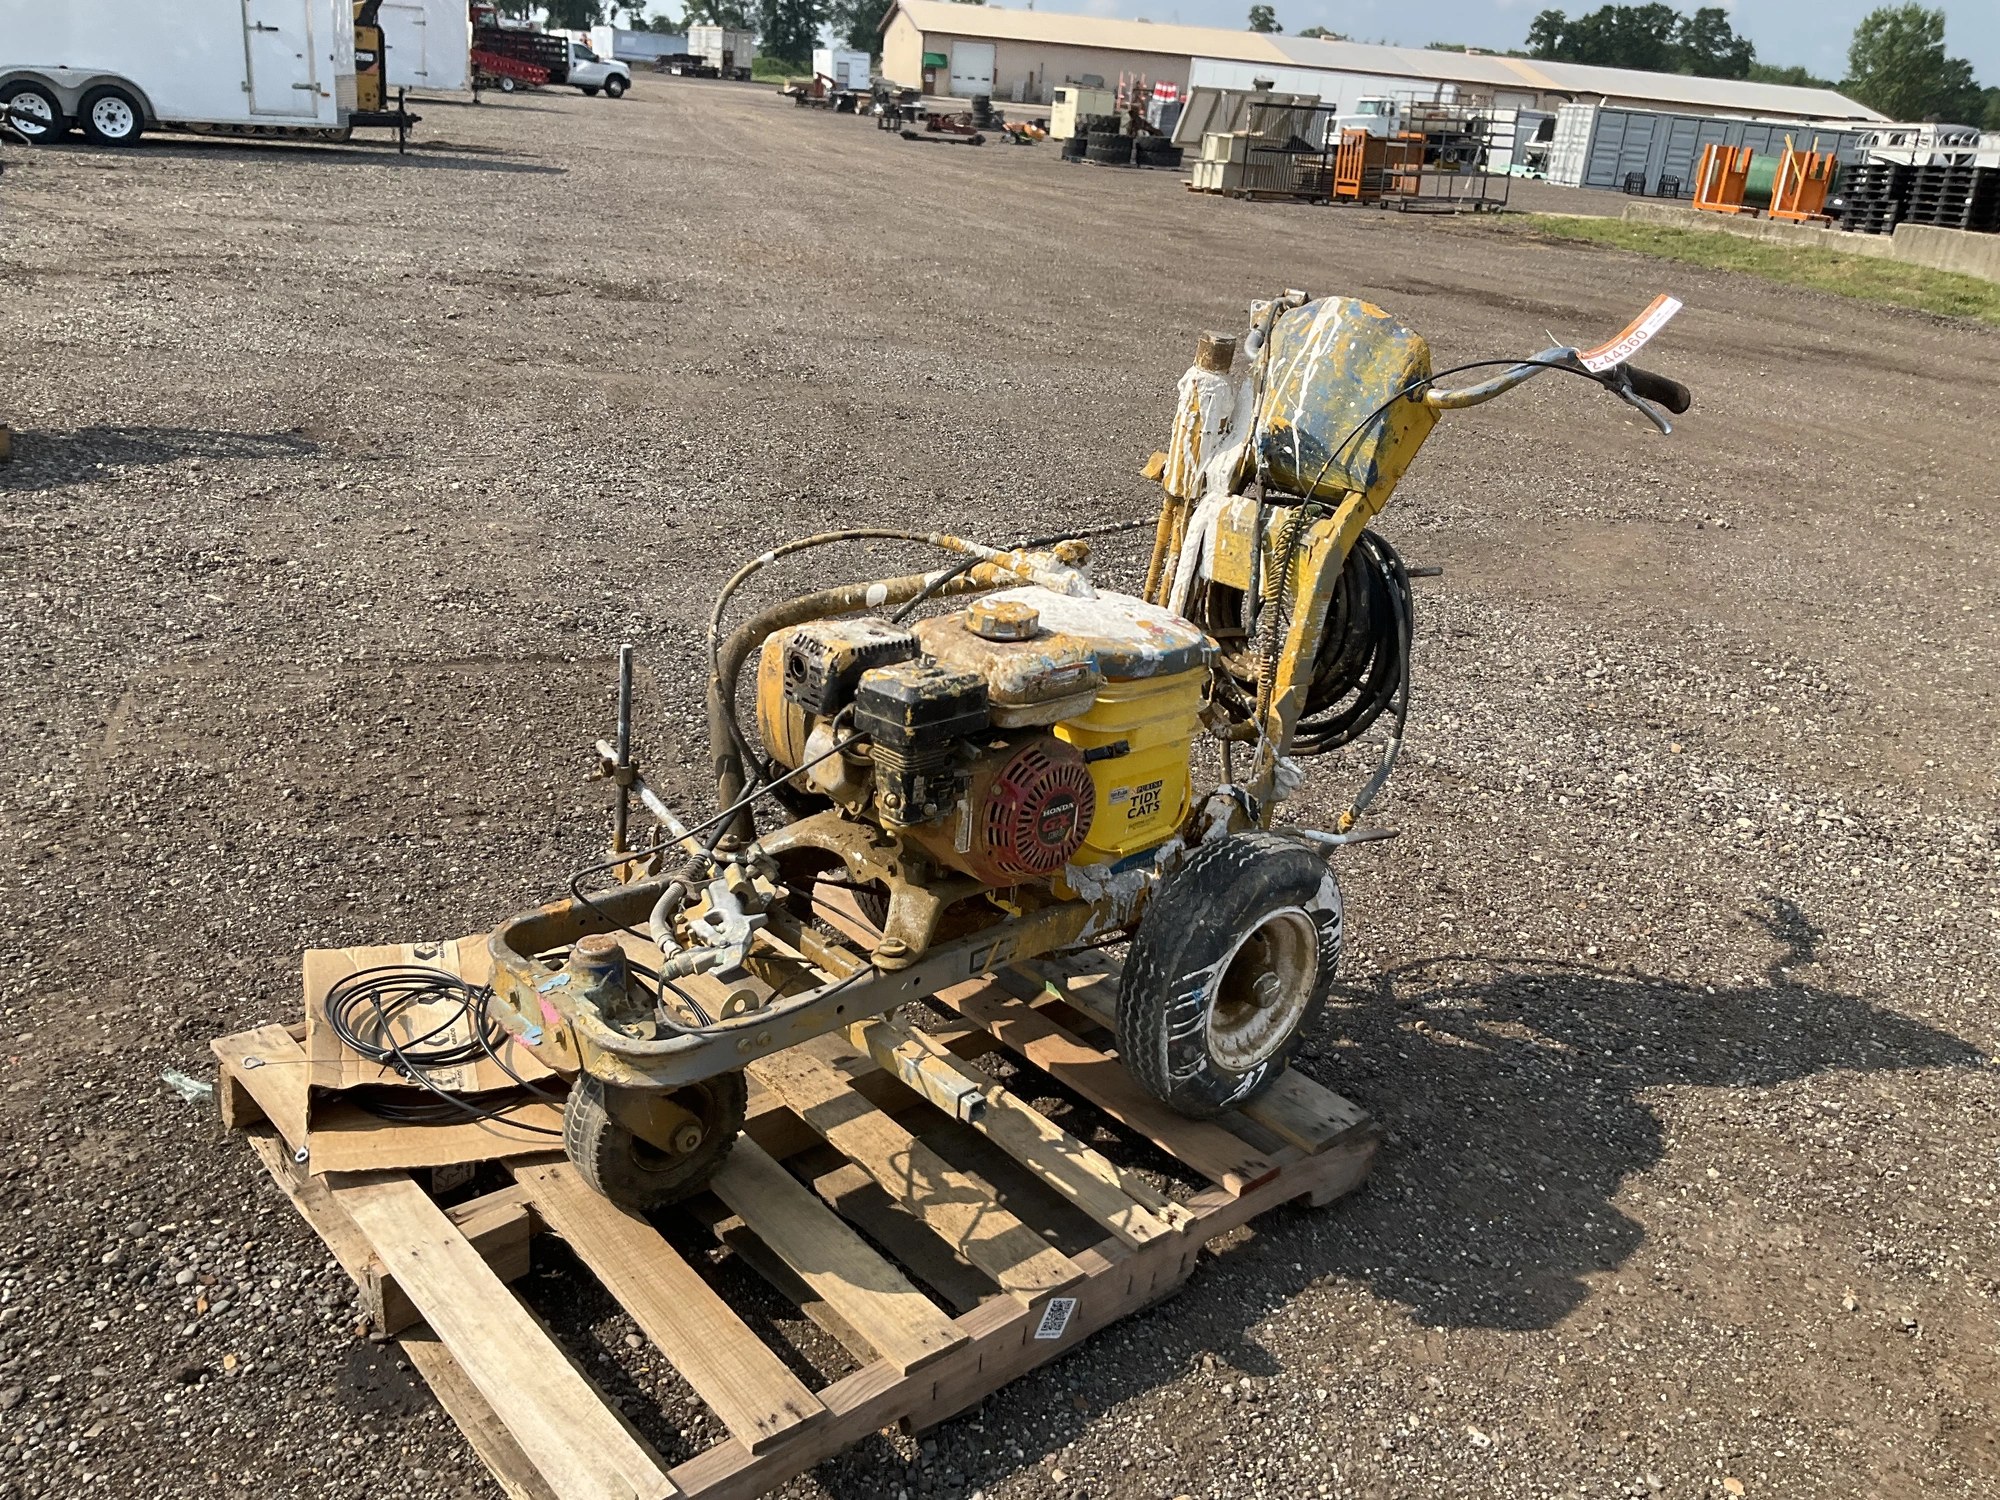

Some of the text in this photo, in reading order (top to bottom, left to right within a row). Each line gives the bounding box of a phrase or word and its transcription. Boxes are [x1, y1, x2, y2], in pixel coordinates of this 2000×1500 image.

[1587, 330, 1648, 370] 2-44360
[1137, 780, 1162, 793] PURINA
[1130, 789, 1161, 807] TIDY
[1042, 802, 1074, 817] HONDA
[1127, 801, 1160, 819] CATS
[1042, 812, 1071, 832] GX
